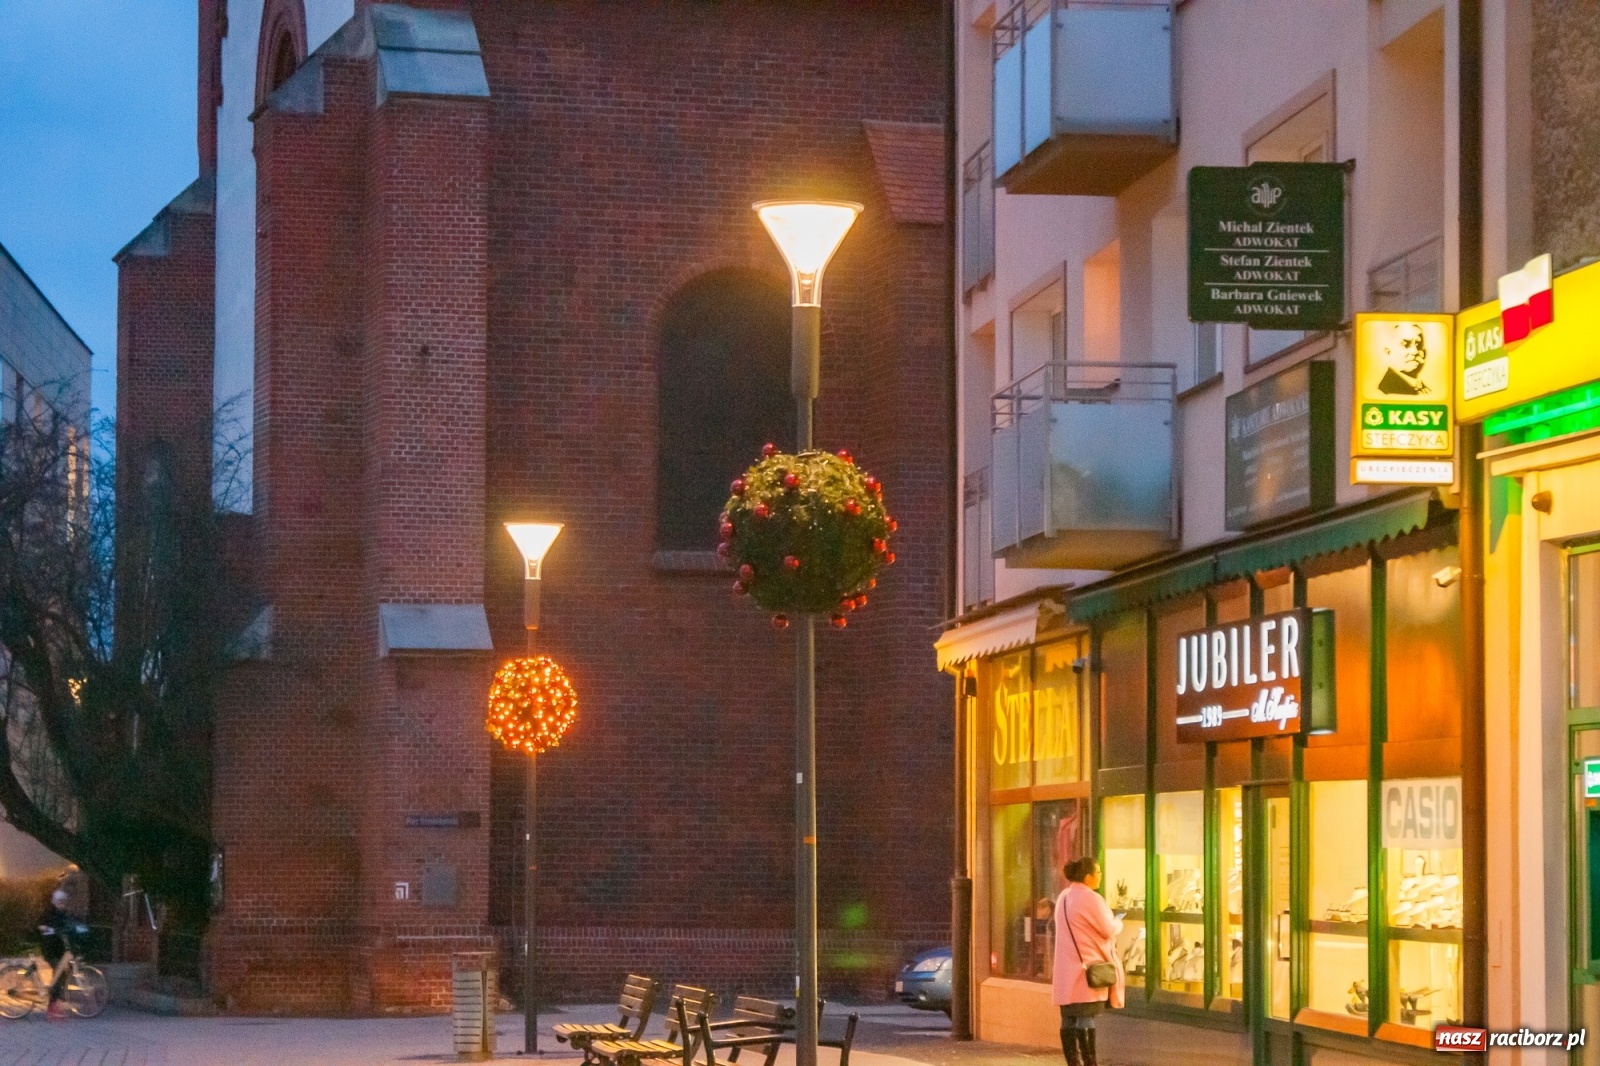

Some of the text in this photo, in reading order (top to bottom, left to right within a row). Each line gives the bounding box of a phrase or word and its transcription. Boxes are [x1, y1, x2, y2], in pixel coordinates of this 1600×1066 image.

[1266, 221, 1314, 234] Zientek
[1233, 236, 1300, 248] ADWOKAT
[1220, 254, 1313, 268] Stefan Zientek
[1234, 270, 1300, 281] ADWOKAT
[1211, 288, 1323, 302] Barbara Gniewek
[1233, 304, 1300, 315] ADWOKAT
[1477, 324, 1504, 354] KAS
[1388, 410, 1444, 426] KASY
[1365, 432, 1446, 446] STEFCZYKA
[1360, 465, 1450, 473] UBEZPIECZENIA
[1176, 615, 1300, 695] JUBILER
[993, 683, 1075, 766] STELLA
[1386, 785, 1459, 840] CASIO
